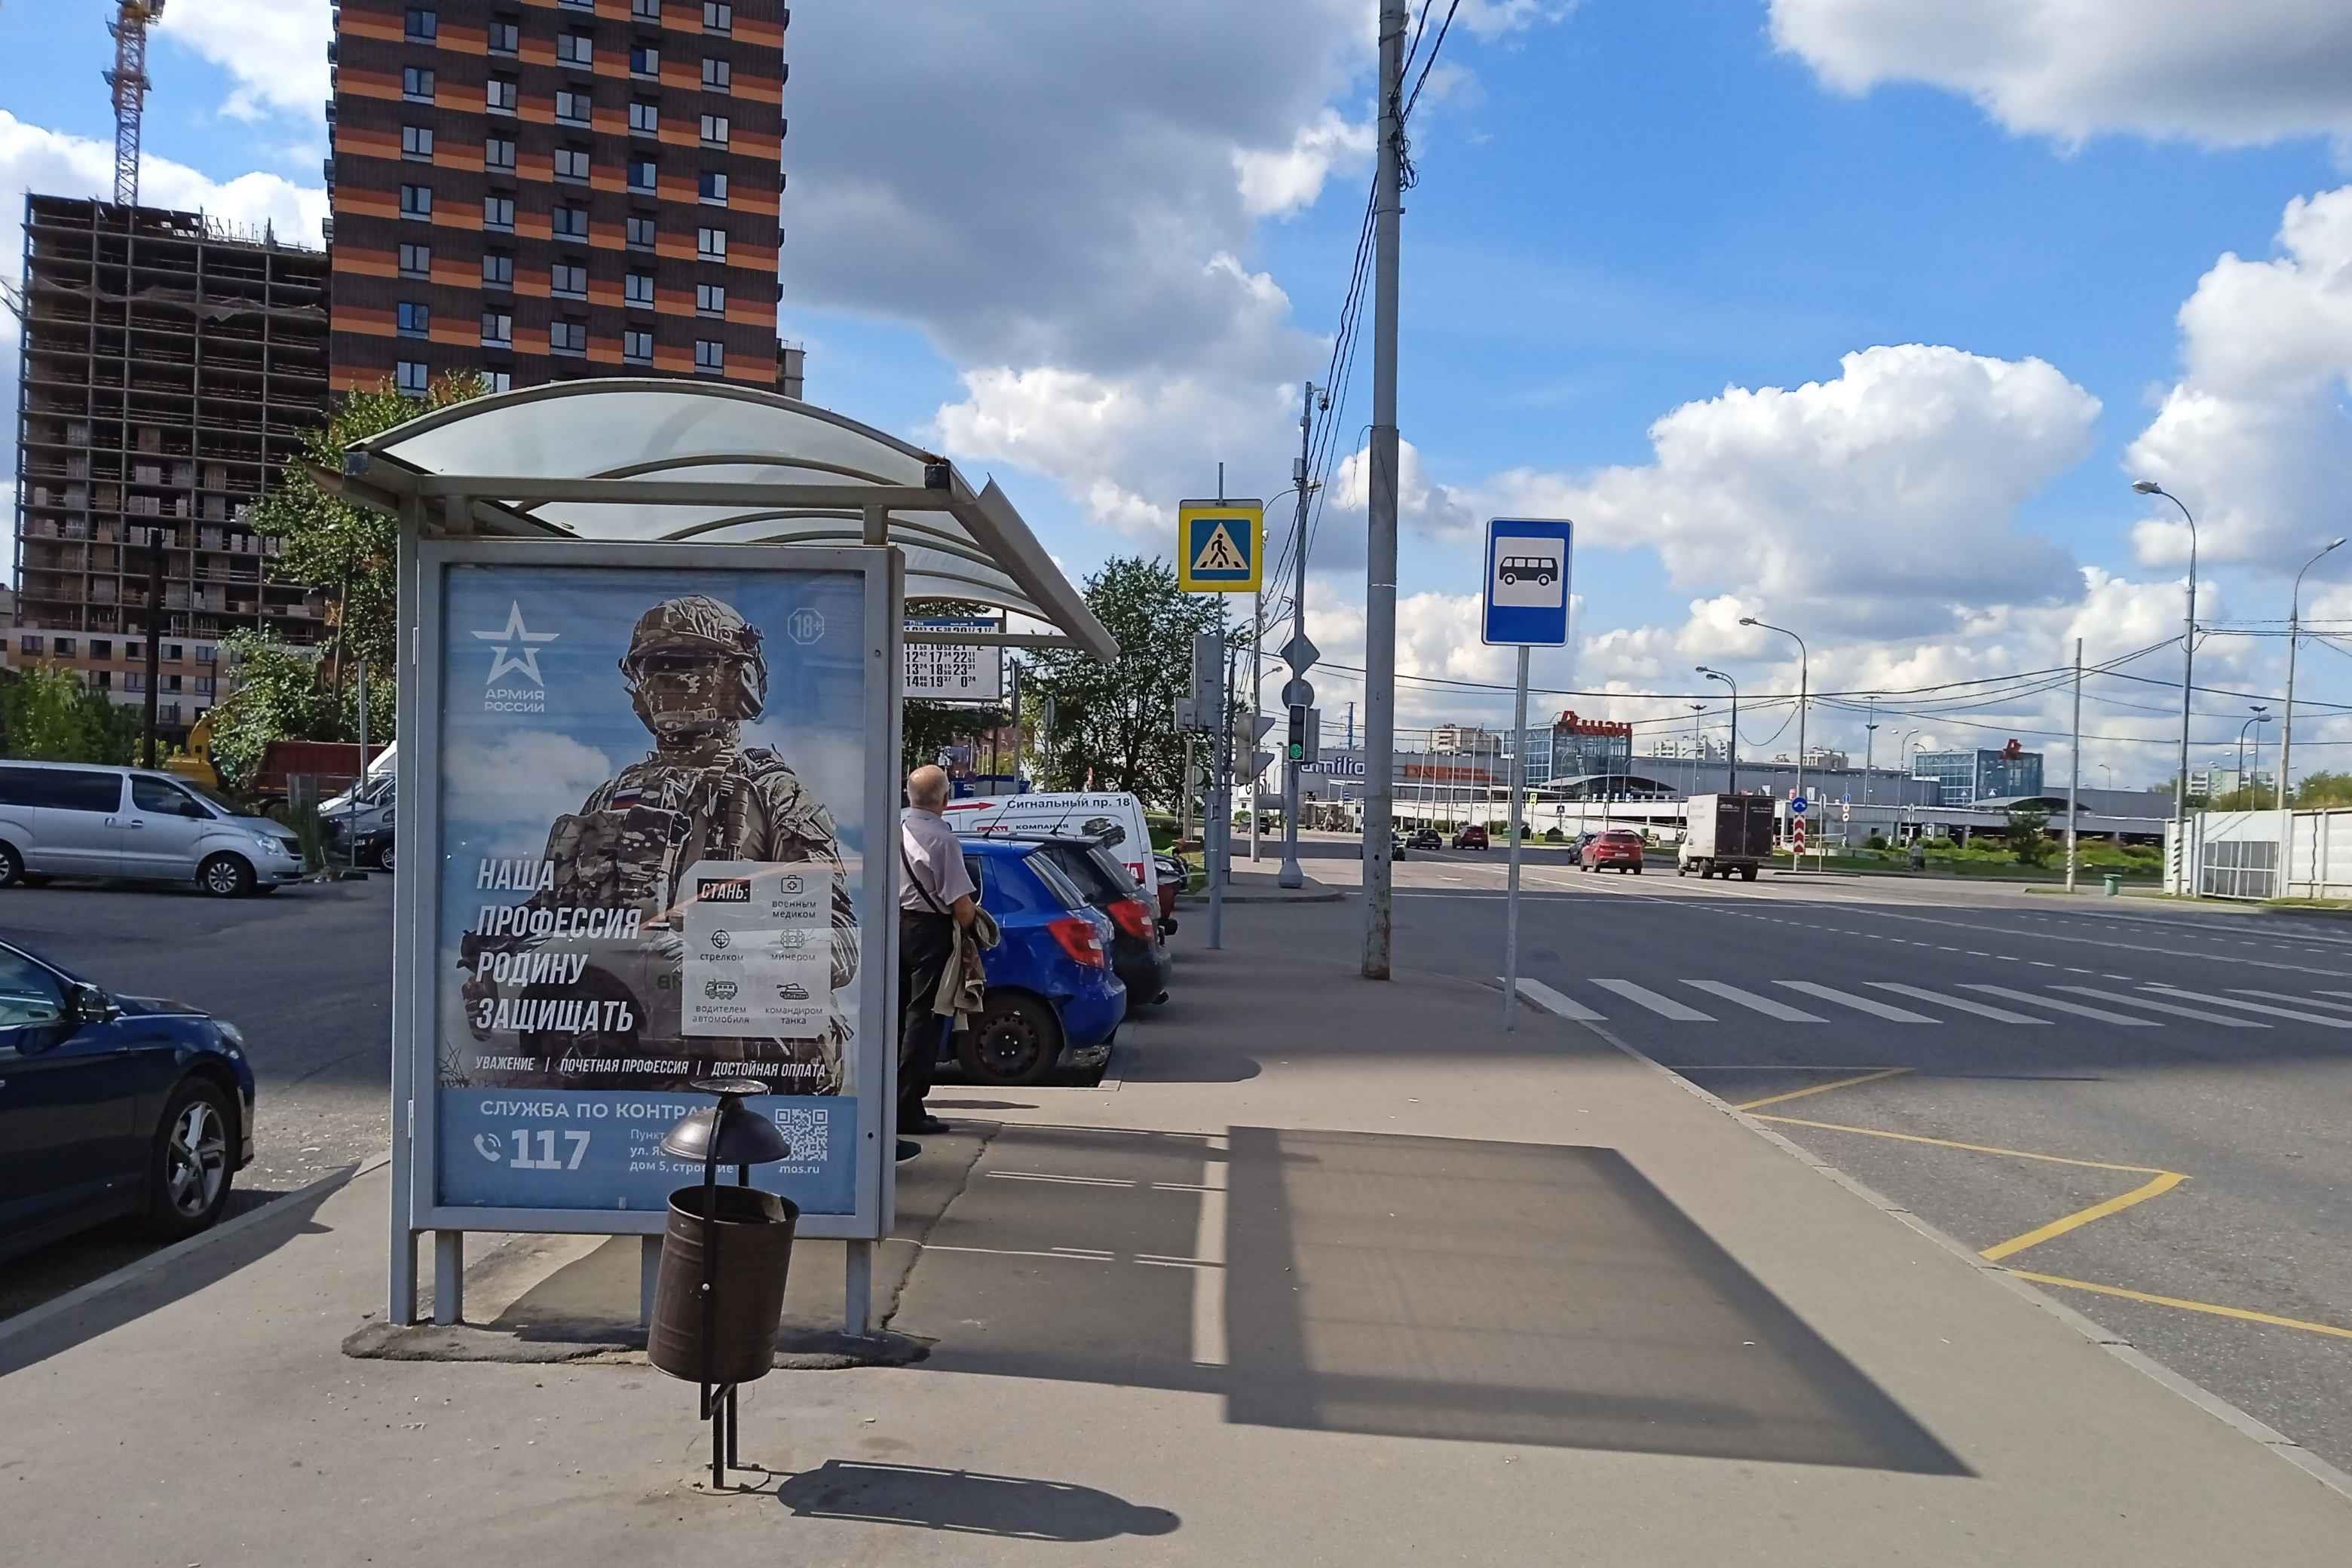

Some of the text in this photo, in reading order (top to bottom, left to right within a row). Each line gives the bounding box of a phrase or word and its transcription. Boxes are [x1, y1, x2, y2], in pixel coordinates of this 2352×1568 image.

[794, 614, 821, 639] 18+
[485, 688, 545, 700] АРМИЯ
[484, 701, 545, 712] РОССИИ
[1300, 756, 1365, 776] amilia
[1007, 797, 1131, 810] Сигнальный пр. 18
[476, 858, 555, 891] НАША
[700, 882, 749, 900] СТАНЬ:
[772, 900, 816, 908] военным
[772, 911, 816, 919] медиком
[476, 905, 643, 940] ПРОФЕССИЯ
[700, 953, 743, 962] стрелком
[476, 951, 590, 987] РОДИНУ
[476, 997, 634, 1035] ЗАЩИЩАТЬ
[695, 1005, 746, 1015] водителем
[764, 1006, 823, 1016] командиром
[692, 1015, 750, 1024] автомобиля
[476, 1055, 536, 1071] УВАЖЕНИЕ
[559, 1058, 618, 1073] ПОЧЕТНАЯ
[621, 1058, 689, 1074] ПРОФЕССИЯ
[711, 1060, 779, 1077] ДОСТОЙНАЯ
[781, 1063, 826, 1078] ОПЛАТА
[479, 1100, 717, 1120] СЛУЖБА ПО КОНТРА
[630, 1129, 665, 1142] Пункт
[510, 1129, 591, 1170] 117
[629, 1147, 648, 1157] ул.
[629, 1161, 734, 1175] дом 5, строие
[779, 1165, 820, 1174] mos.ru
